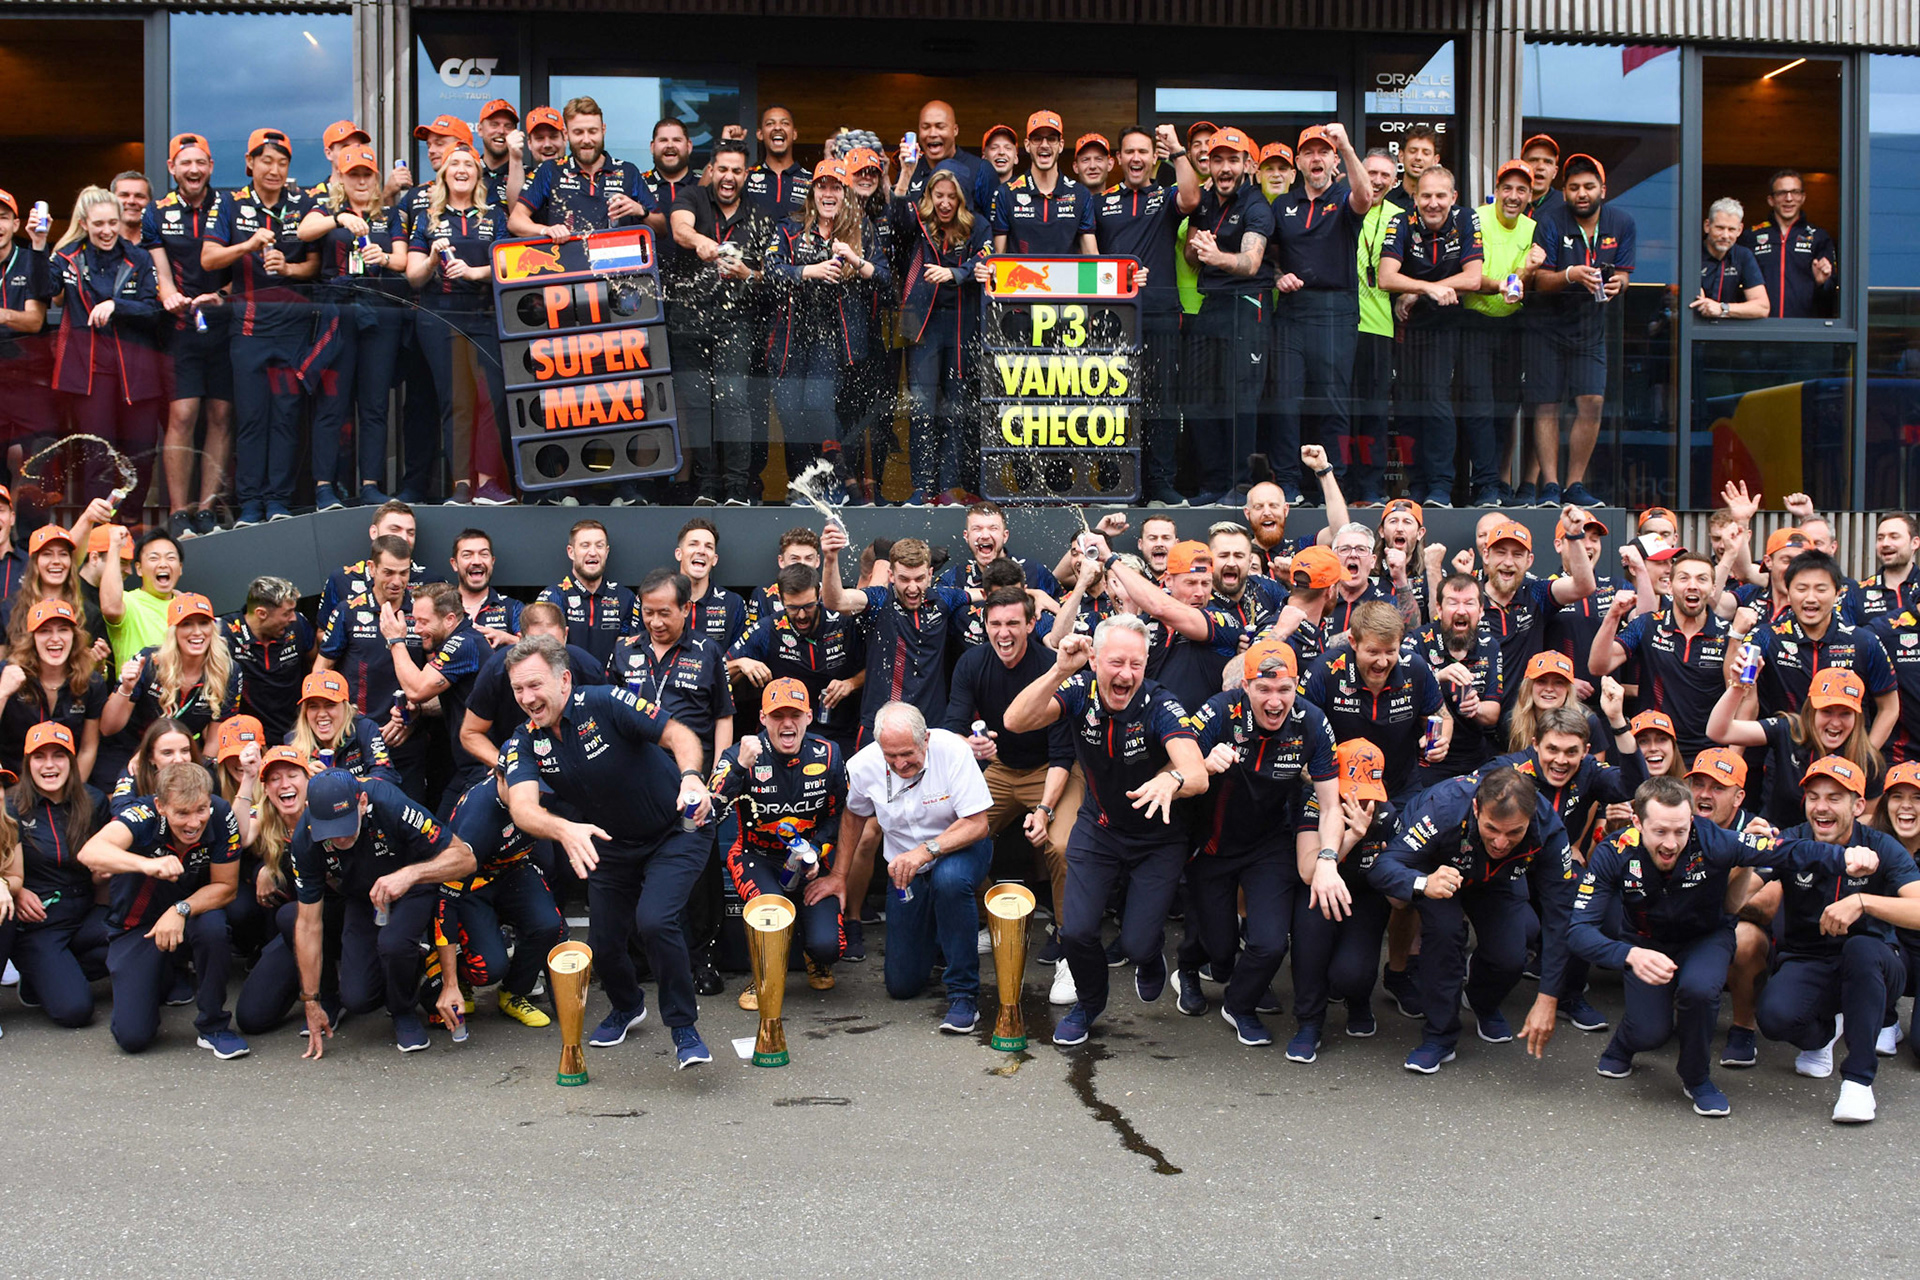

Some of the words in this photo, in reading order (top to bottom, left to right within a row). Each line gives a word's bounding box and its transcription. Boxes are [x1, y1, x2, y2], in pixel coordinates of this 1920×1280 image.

[1376, 73, 1451, 86] ORACLE
[531, 331, 650, 382] SUPER
[998, 357, 1128, 396] VAMOS
[544, 380, 646, 430] MAX!
[1002, 408, 1126, 448] CHECO!
[1301, 620, 1315, 634] zoom
[826, 644, 843, 655] BYBIT
[681, 681, 698, 690] Tezos
[1334, 697, 1353, 705] Mobil
[1391, 696, 1412, 707] BYBIT
[1390, 705, 1413, 714] HONDA
[585, 735, 602, 752] BYBIT
[586, 743, 610, 760] HONDA
[804, 779, 826, 789] BYBIT
[756, 797, 825, 814] ORACLE
